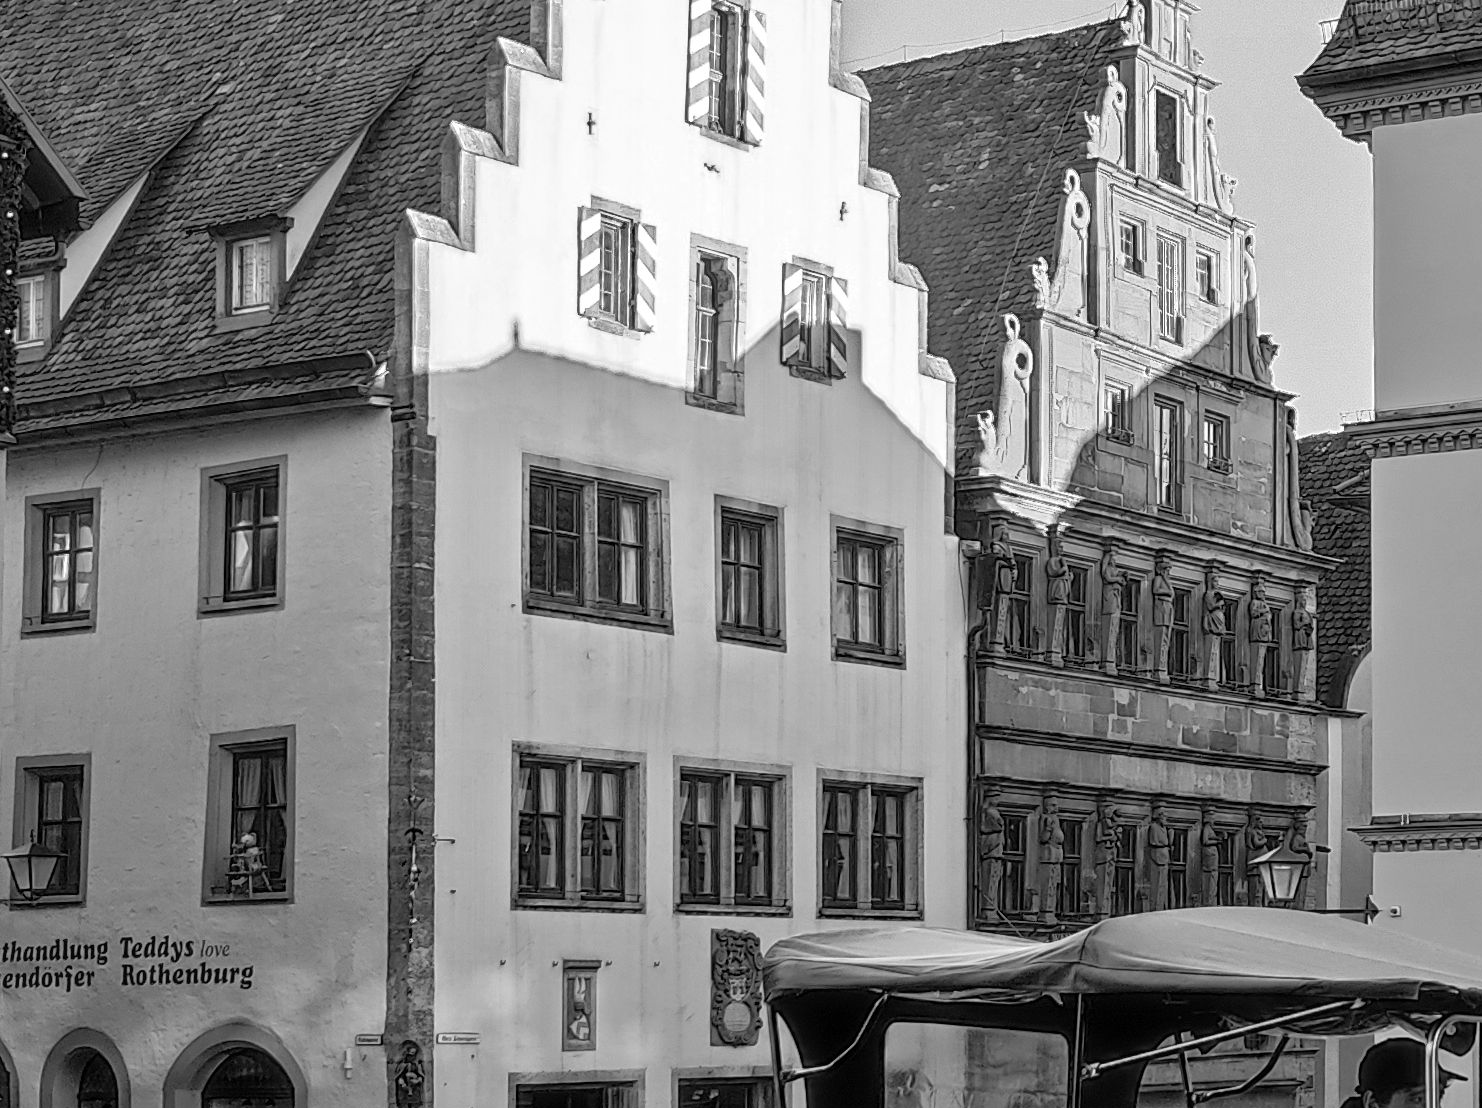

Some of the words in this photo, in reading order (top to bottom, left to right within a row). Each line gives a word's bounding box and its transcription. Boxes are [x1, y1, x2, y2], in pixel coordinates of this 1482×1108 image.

[120, 935, 195, 963] Teddys
[200, 939, 230, 958] love
[121, 962, 254, 990] Rothenburg
